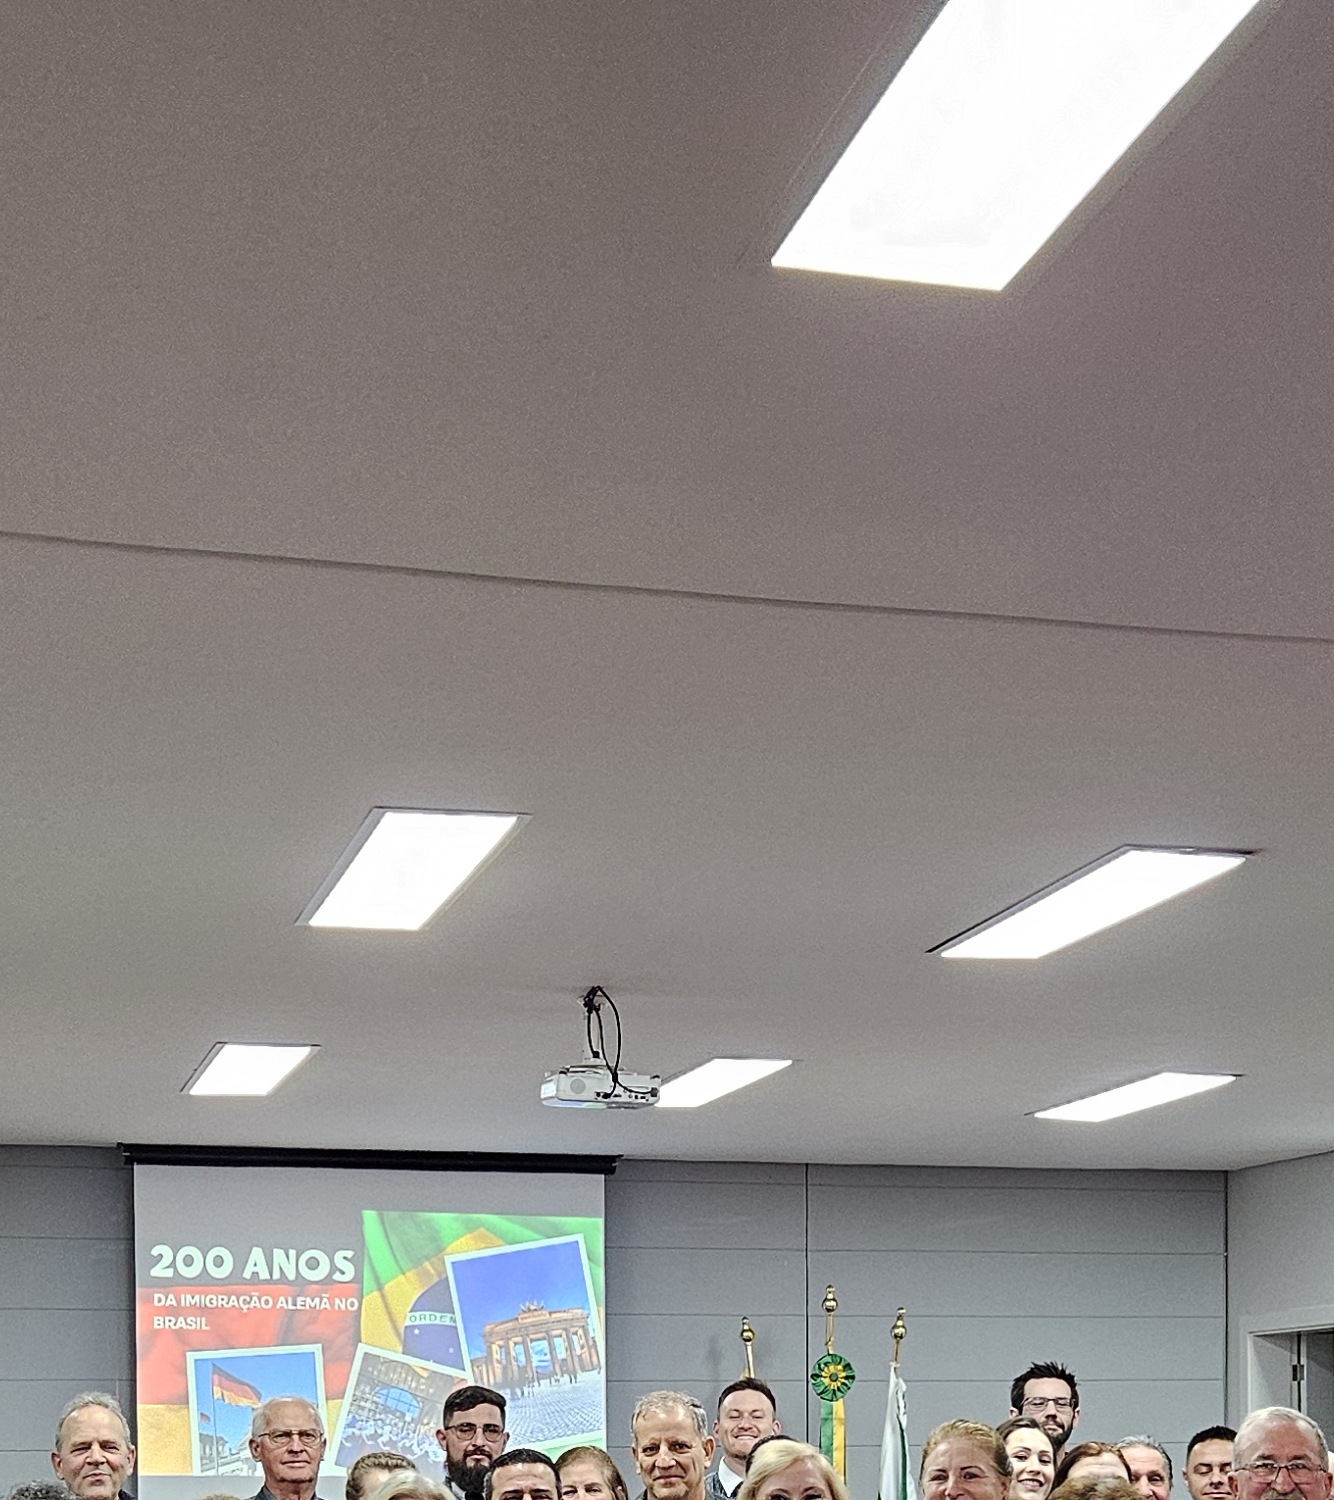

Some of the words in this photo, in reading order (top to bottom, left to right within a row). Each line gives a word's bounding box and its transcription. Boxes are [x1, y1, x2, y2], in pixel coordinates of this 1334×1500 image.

[149, 1244, 234, 1280] 200
[242, 1246, 356, 1283] ANOS
[153, 1293, 177, 1308] DA
[180, 1292, 273, 1313] IMIGRAÇÃO
[276, 1294, 331, 1311] ALEMÃ
[334, 1298, 359, 1312] NO
[153, 1315, 210, 1331] BRASIL
